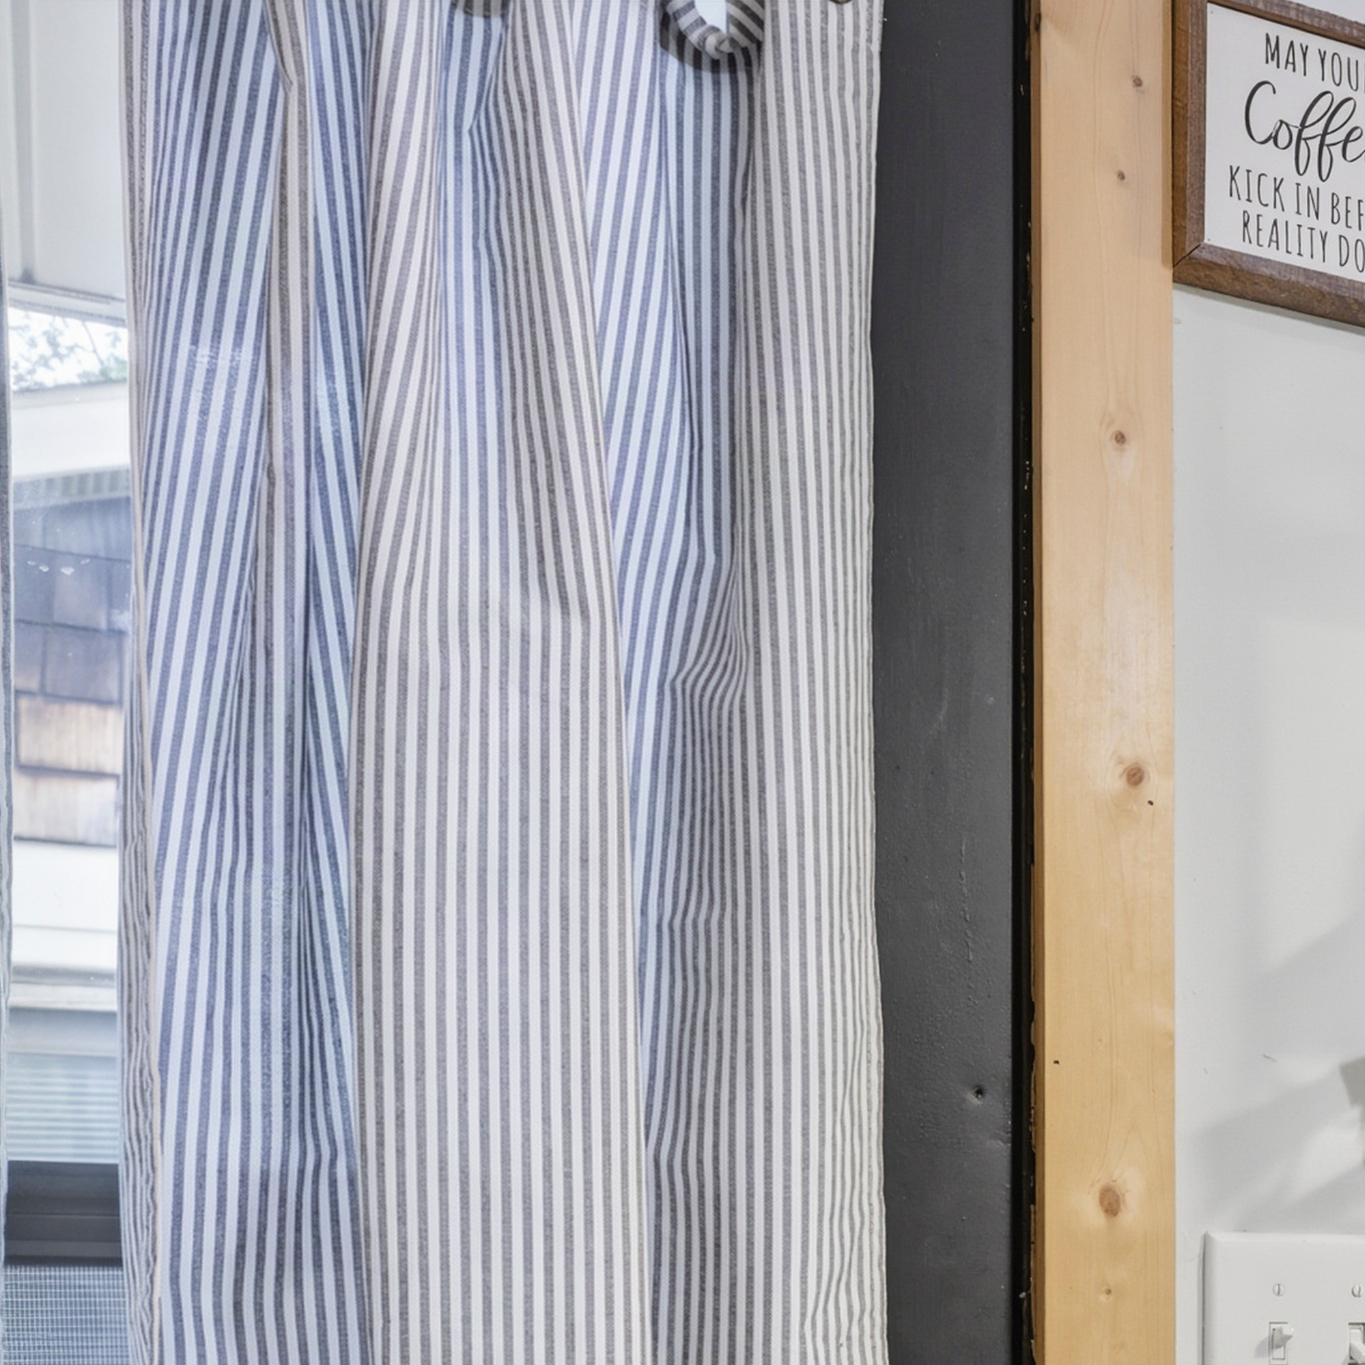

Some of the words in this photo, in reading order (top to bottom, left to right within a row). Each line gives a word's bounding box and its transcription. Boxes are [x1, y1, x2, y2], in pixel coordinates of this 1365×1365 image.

[1265, 33, 1308, 76] MAY
[1229, 165, 1285, 212] KICK
[1295, 183, 1320, 220] IN
[1242, 210, 1328, 263] REALITY
